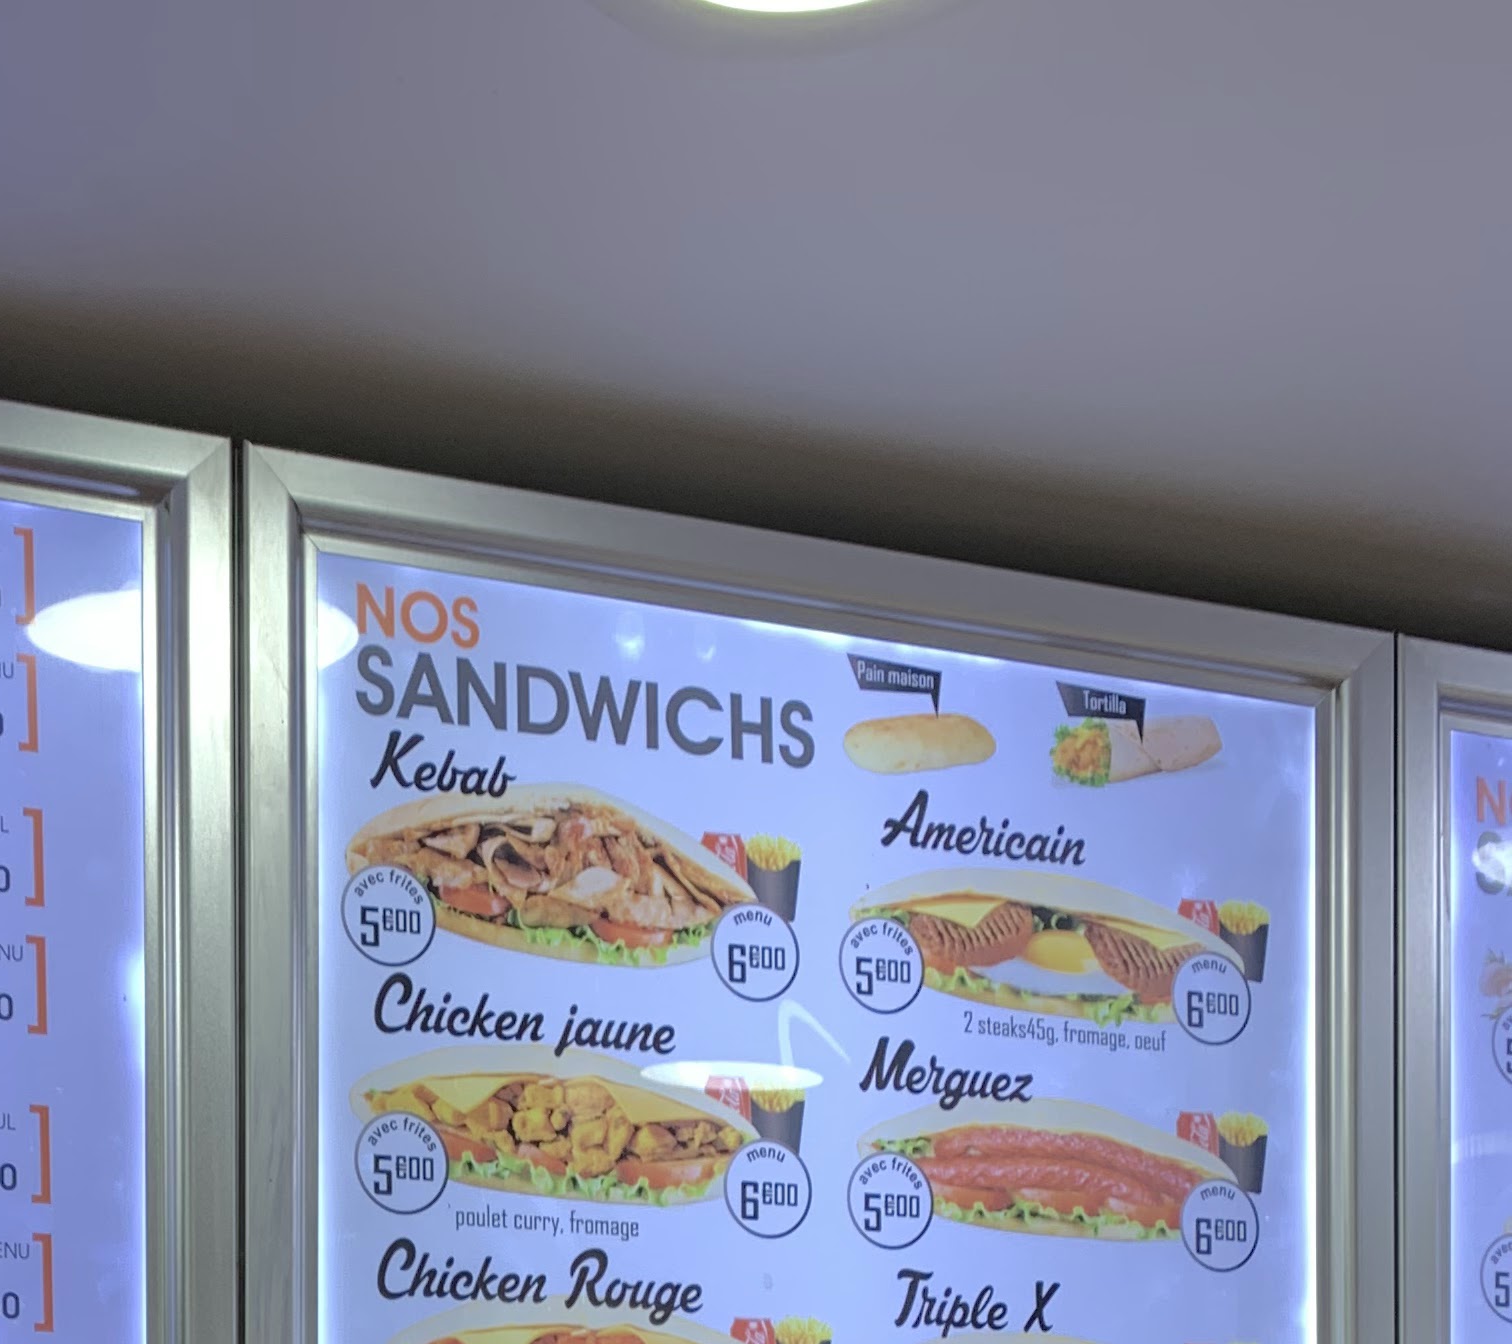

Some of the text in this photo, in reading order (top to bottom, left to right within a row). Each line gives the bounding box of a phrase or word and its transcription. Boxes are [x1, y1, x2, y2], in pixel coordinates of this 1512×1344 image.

[355, 583, 480, 649] NOS
[856, 660, 935, 689] Pain maison
[355, 644, 815, 769] SANDWICHS
[1082, 690, 1127, 715] Tortilla
[370, 730, 516, 798] Kebab
[880, 789, 1088, 866] Americain
[354, 869, 424, 906] avec frites
[733, 910, 773, 928] menu
[373, 972, 676, 1057] Chicken jaune
[964, 1011, 974, 1034] 2
[1134, 1030, 1167, 1053] oeuf
[859, 1035, 1034, 1111] Merguez
[746, 1148, 786, 1164] menu
[858, 1160, 888, 1186] avec
[1199, 1186, 1236, 1202] menu
[455, 1207, 639, 1241] poulet curry, fromage
[377, 1238, 704, 1326] Chicken Rouge
[894, 1268, 1061, 1338] Triple X
